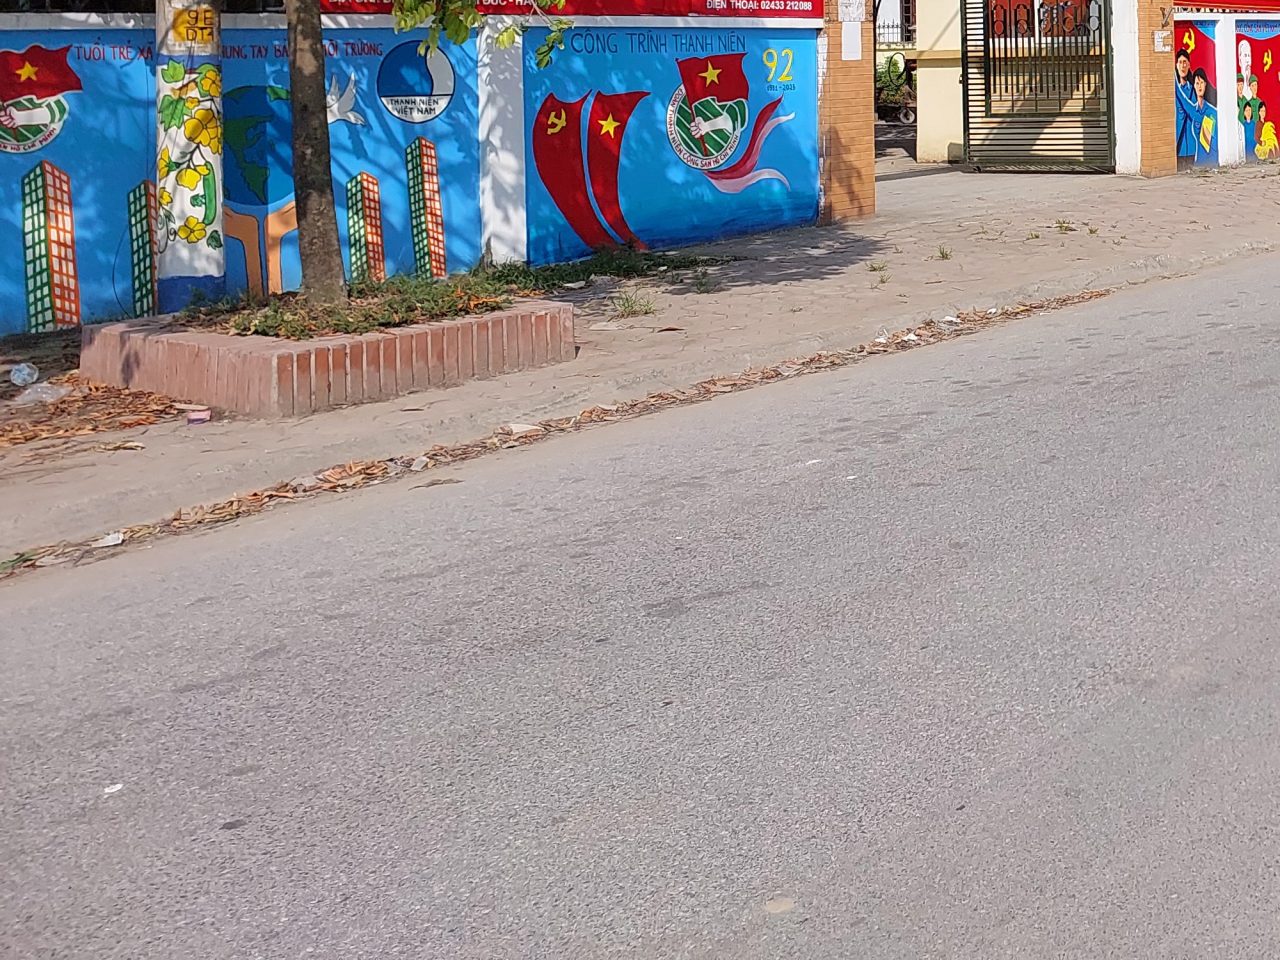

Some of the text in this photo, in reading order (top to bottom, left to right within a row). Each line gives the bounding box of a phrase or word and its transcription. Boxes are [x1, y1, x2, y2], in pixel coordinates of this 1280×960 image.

[730, 0, 759, 12] THOẠI:
[760, 0, 785, 10] 02433
[786, 1, 812, 11] 212088
[74, 36, 106, 61] TUỔI
[109, 40, 132, 61] TRẺ
[250, 45, 268, 58] TAY
[571, 29, 747, 54] CÔNG TRÌNH THANH NIÊN
[762, 48, 794, 82] 92
[417, 107, 437, 115] NAM
